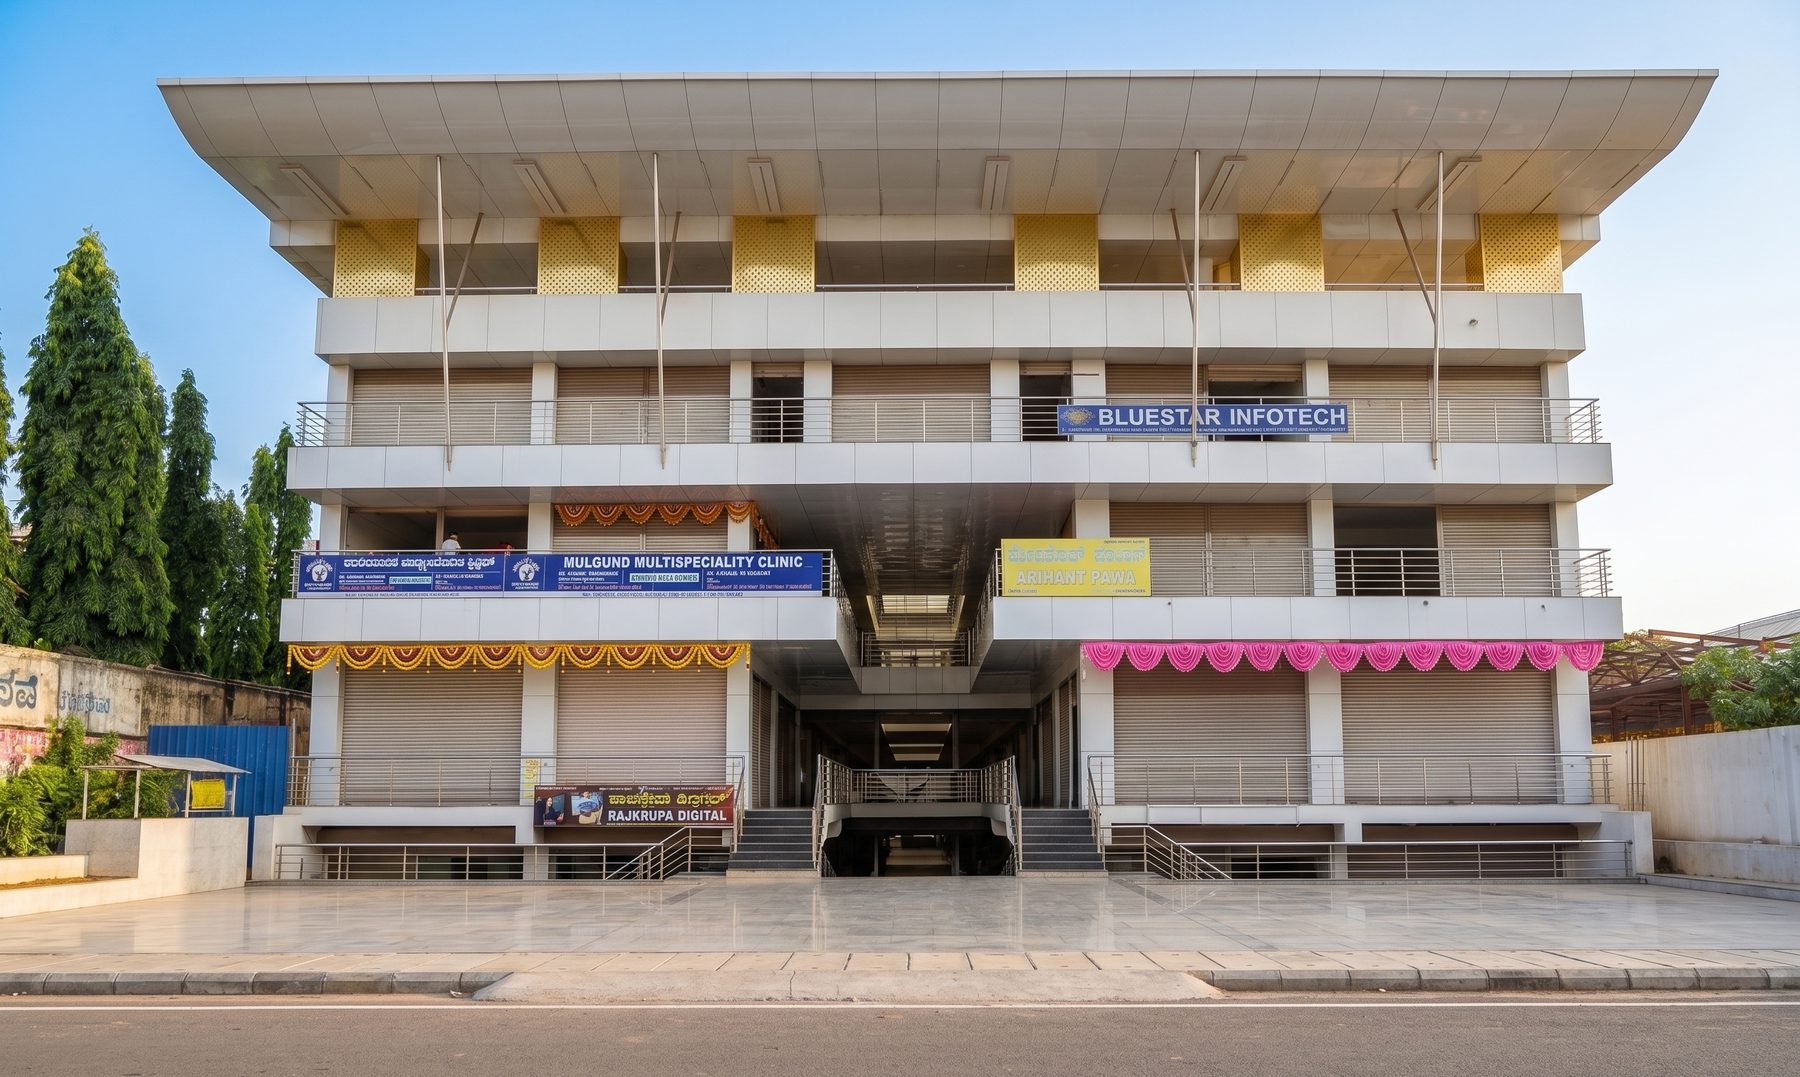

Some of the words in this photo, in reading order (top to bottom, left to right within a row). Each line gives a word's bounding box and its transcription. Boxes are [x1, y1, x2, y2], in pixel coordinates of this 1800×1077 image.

[1098, 408, 1221, 426] BLUESTAR
[1230, 408, 1346, 426] INFOTECH
[563, 556, 631, 569] MULGUND
[634, 556, 754, 569] MULTISPECIALITY
[757, 556, 803, 568] CLINIC
[1016, 570, 1087, 586] ARIHANT
[1090, 570, 1136, 586] PAWA
[608, 810, 674, 822] RAJKRUPA
[678, 810, 727, 822] DIGITAL
